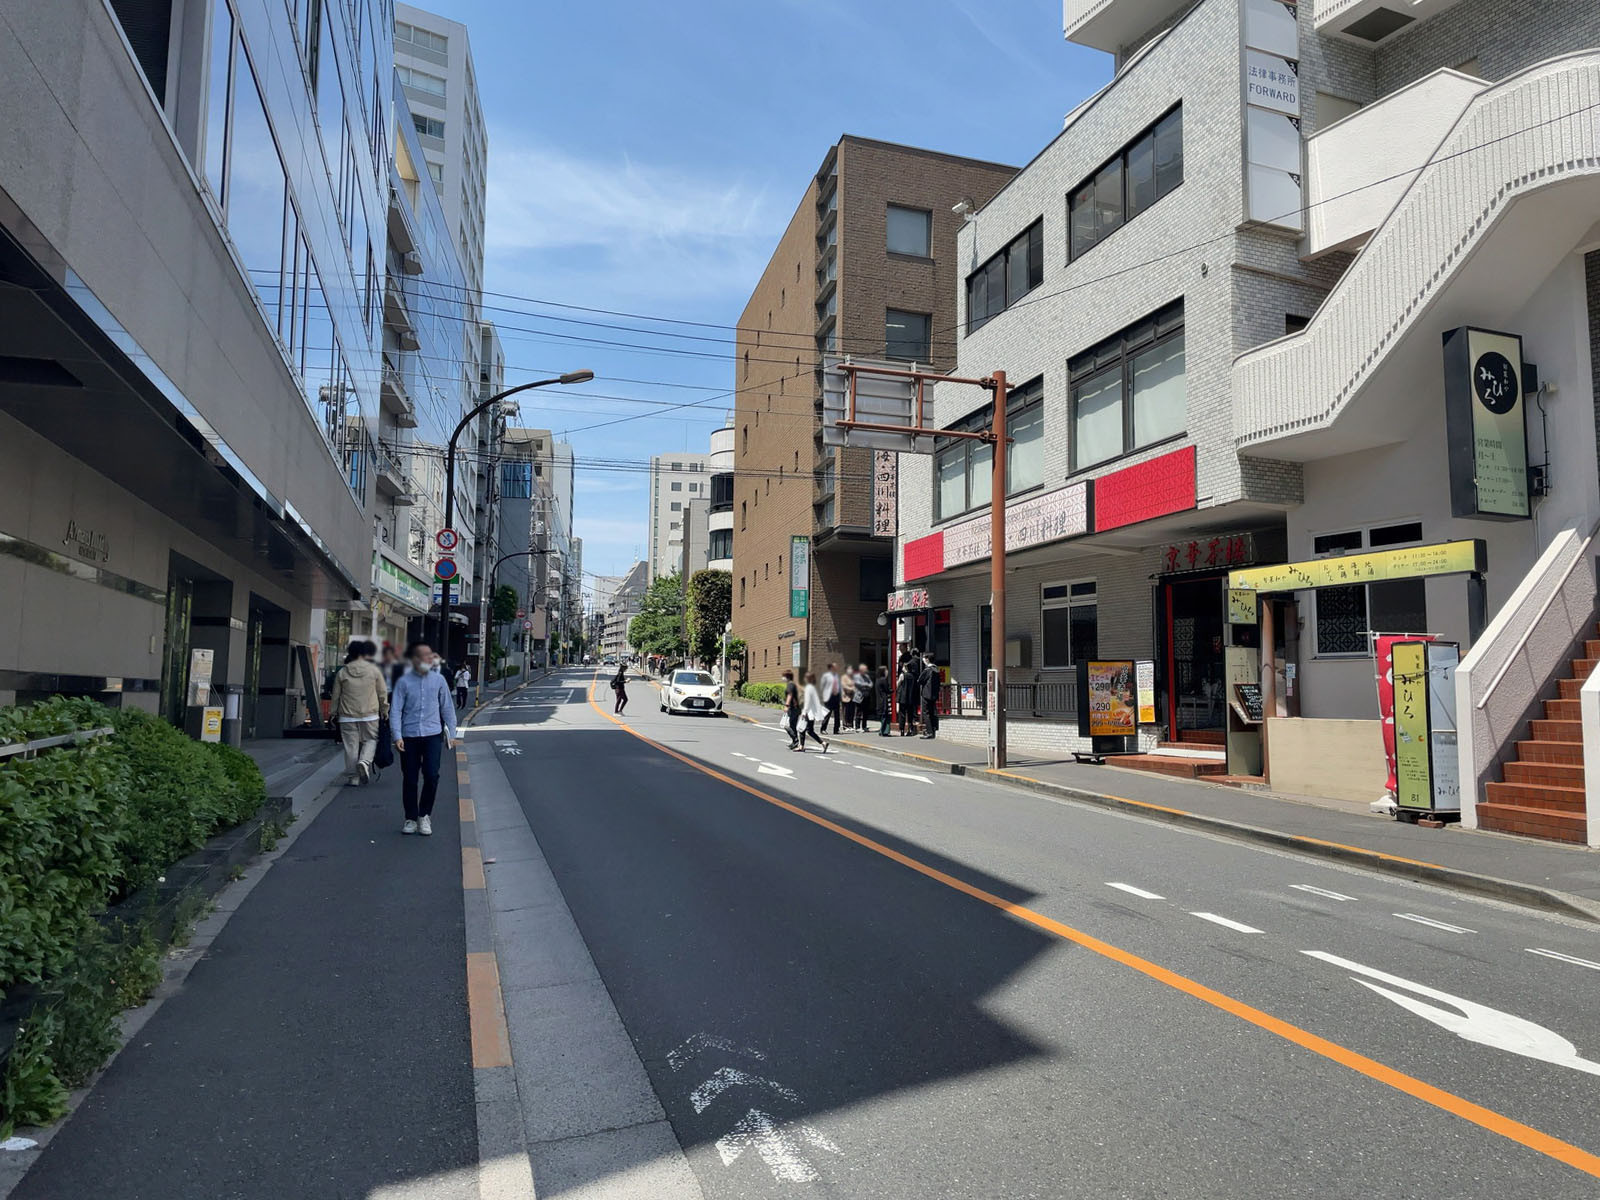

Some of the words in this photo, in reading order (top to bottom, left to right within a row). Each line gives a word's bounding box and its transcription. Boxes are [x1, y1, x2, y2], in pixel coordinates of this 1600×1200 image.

[1248, 65, 1296, 87] 法律事務所
[1249, 83, 1296, 104] FORWARD
